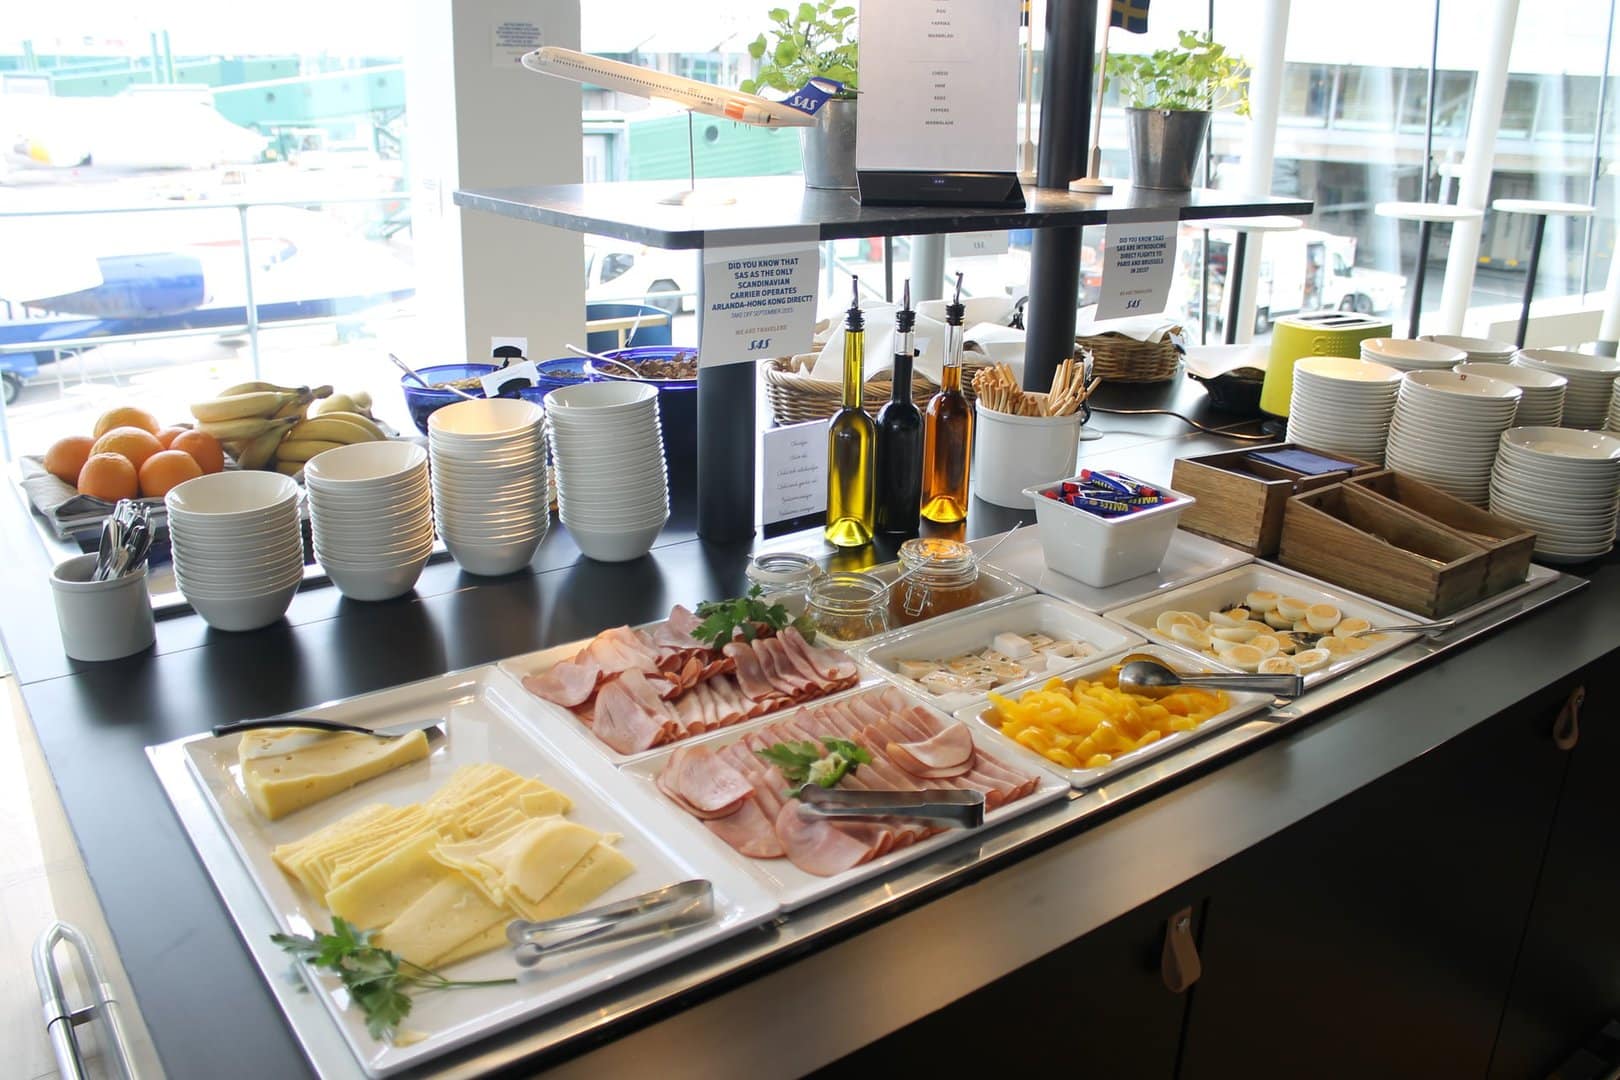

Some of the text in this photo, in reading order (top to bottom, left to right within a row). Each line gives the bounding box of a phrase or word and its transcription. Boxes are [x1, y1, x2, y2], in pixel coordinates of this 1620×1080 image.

[790, 95, 818, 111] SAS
[758, 259, 780, 268] KNOW
[781, 258, 799, 266] THAT
[738, 278, 790, 288] SCANDINAVIAN
[730, 287, 797, 299] CARRIER OPERATES
[712, 299, 766, 310] ARLANDA-HONG
[787, 295, 812, 303] DIRECT?
[1125, 299, 1141, 309] SAS
[748, 338, 772, 350] SAS
